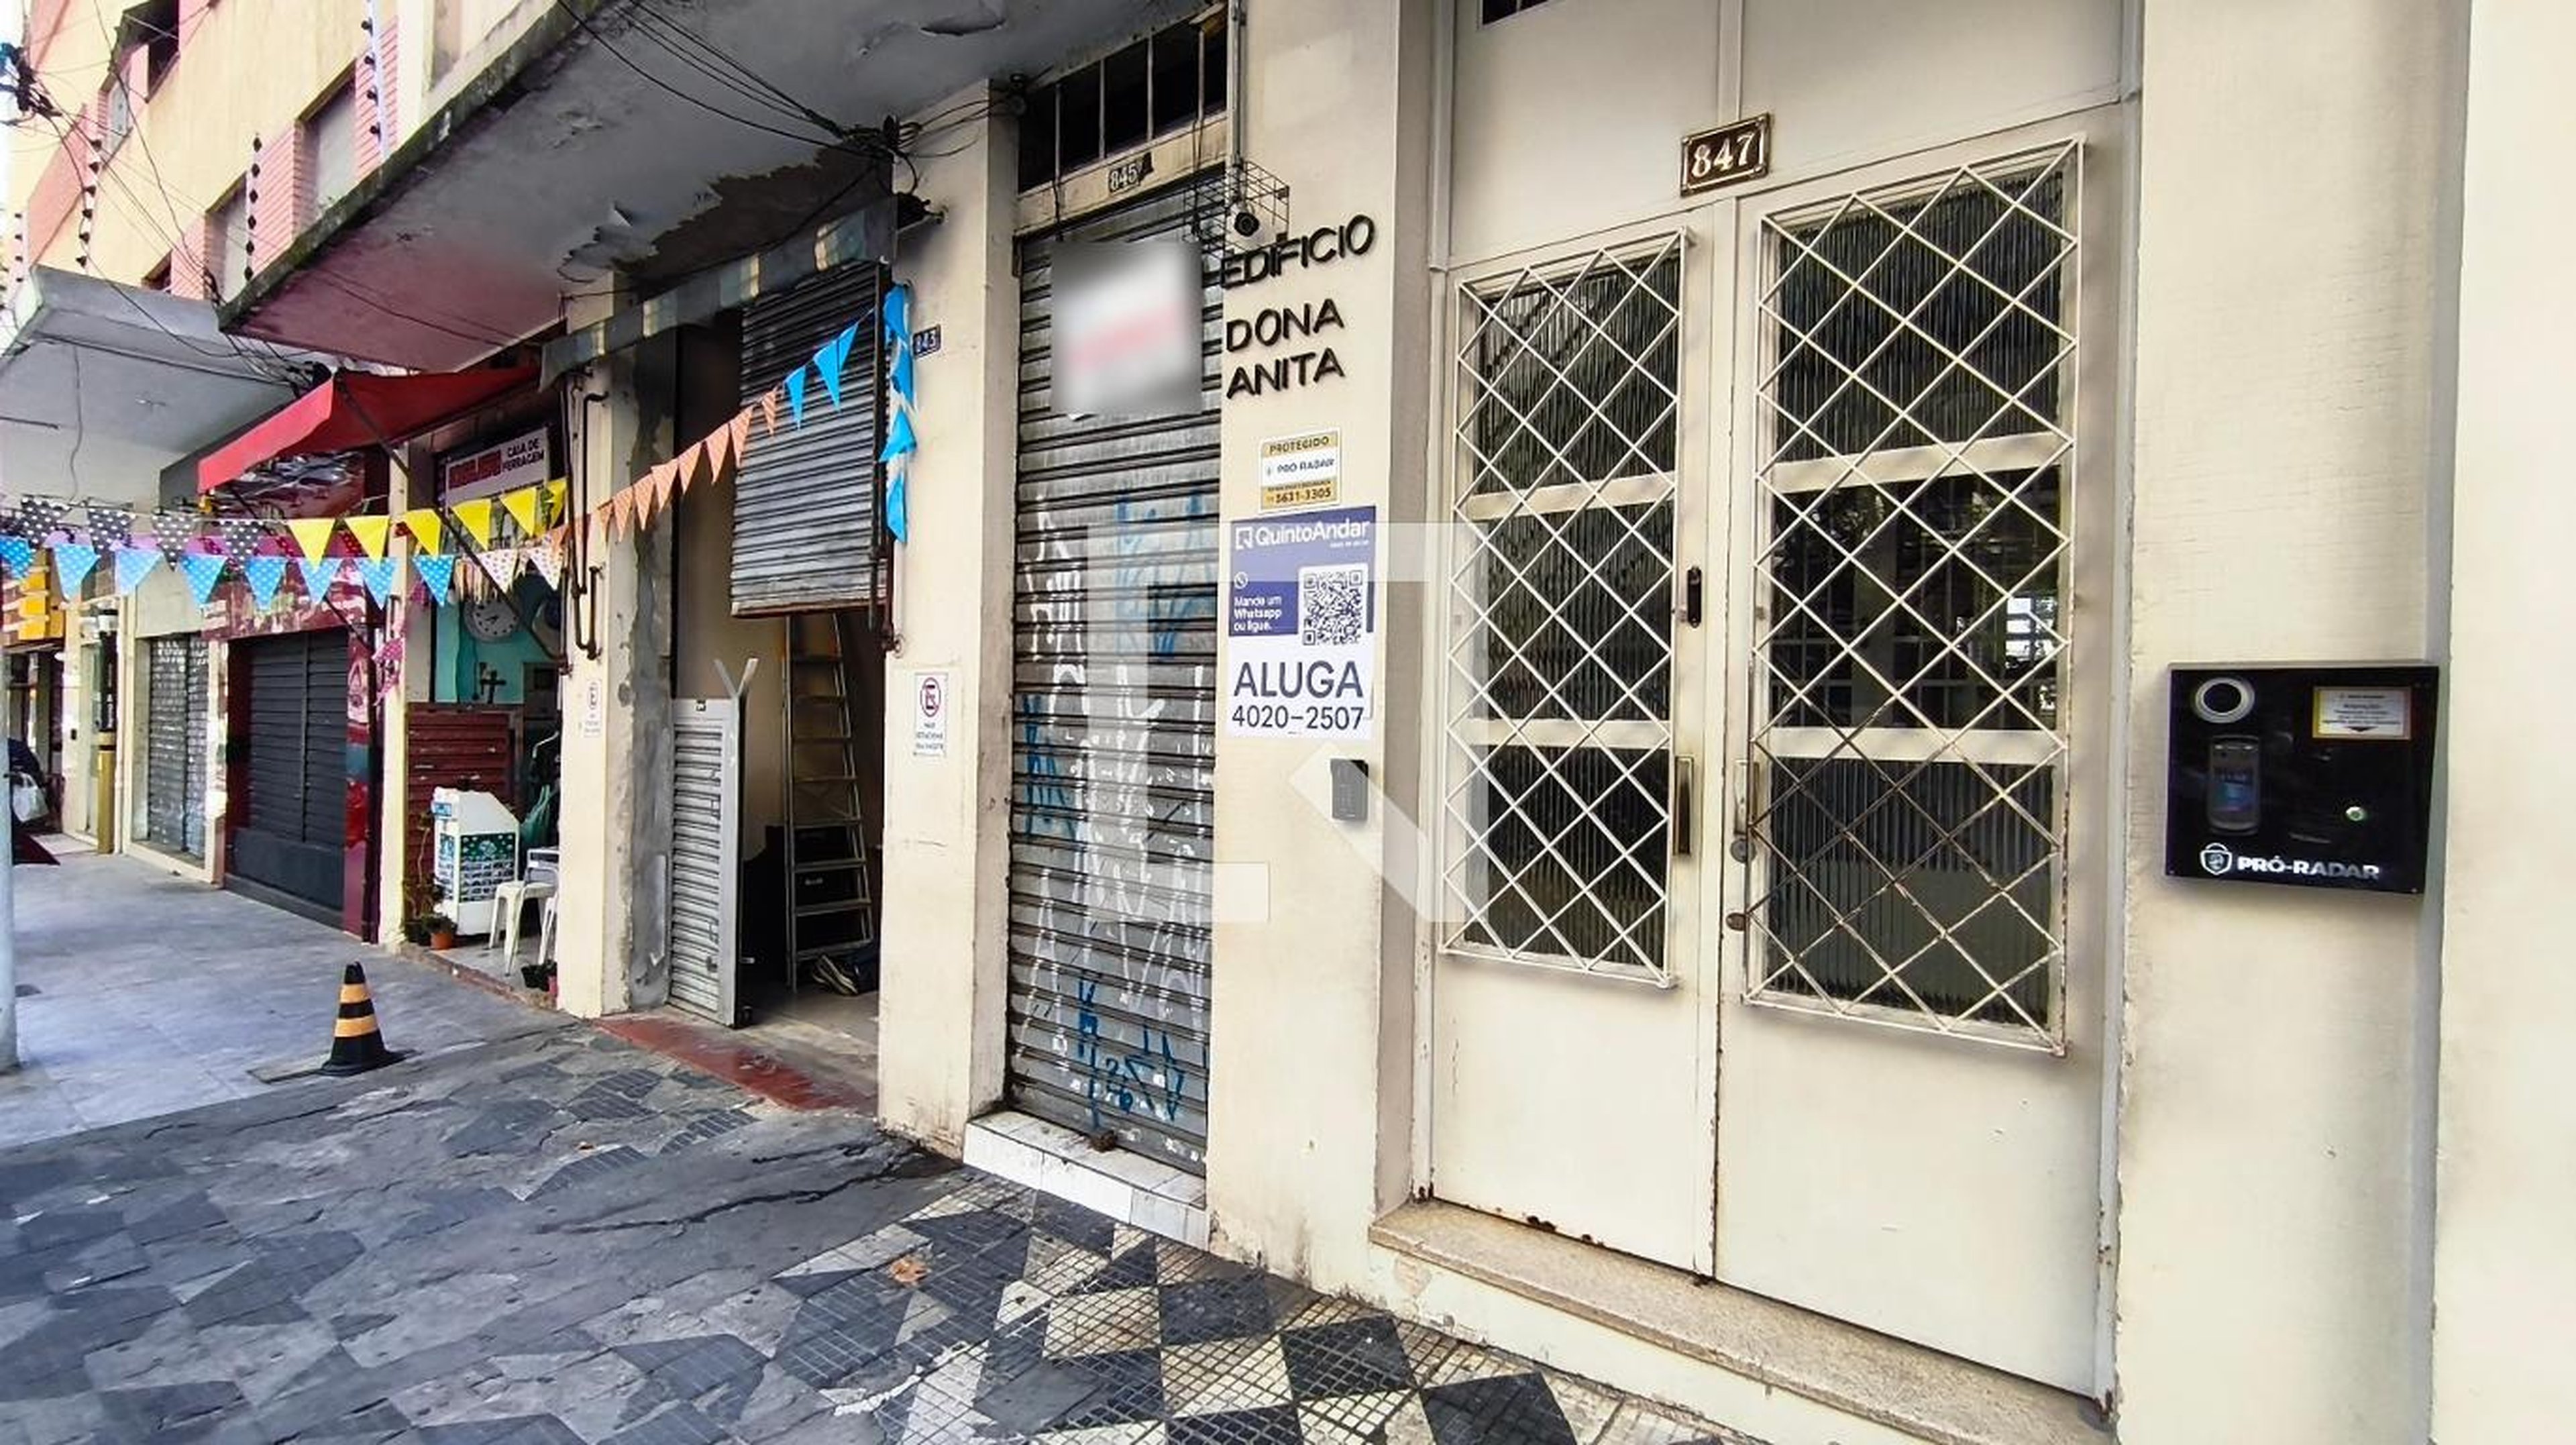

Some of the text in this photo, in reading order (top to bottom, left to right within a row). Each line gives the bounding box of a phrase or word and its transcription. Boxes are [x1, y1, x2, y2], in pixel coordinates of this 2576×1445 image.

[1691, 131, 1756, 177] 847
[1110, 163, 1138, 191] 845
[1226, 299, 1345, 353] DONA
[1226, 347, 1346, 399] ANITA
[1270, 435, 1330, 456] PROTEGIDO
[1255, 518, 1371, 547] QuintoAndar
[1267, 596, 1283, 606] um
[1234, 660, 1364, 699] ALUGA
[1232, 704, 1364, 730] 4020-2507
[2237, 855, 2380, 880] PRÓ-RADAR
